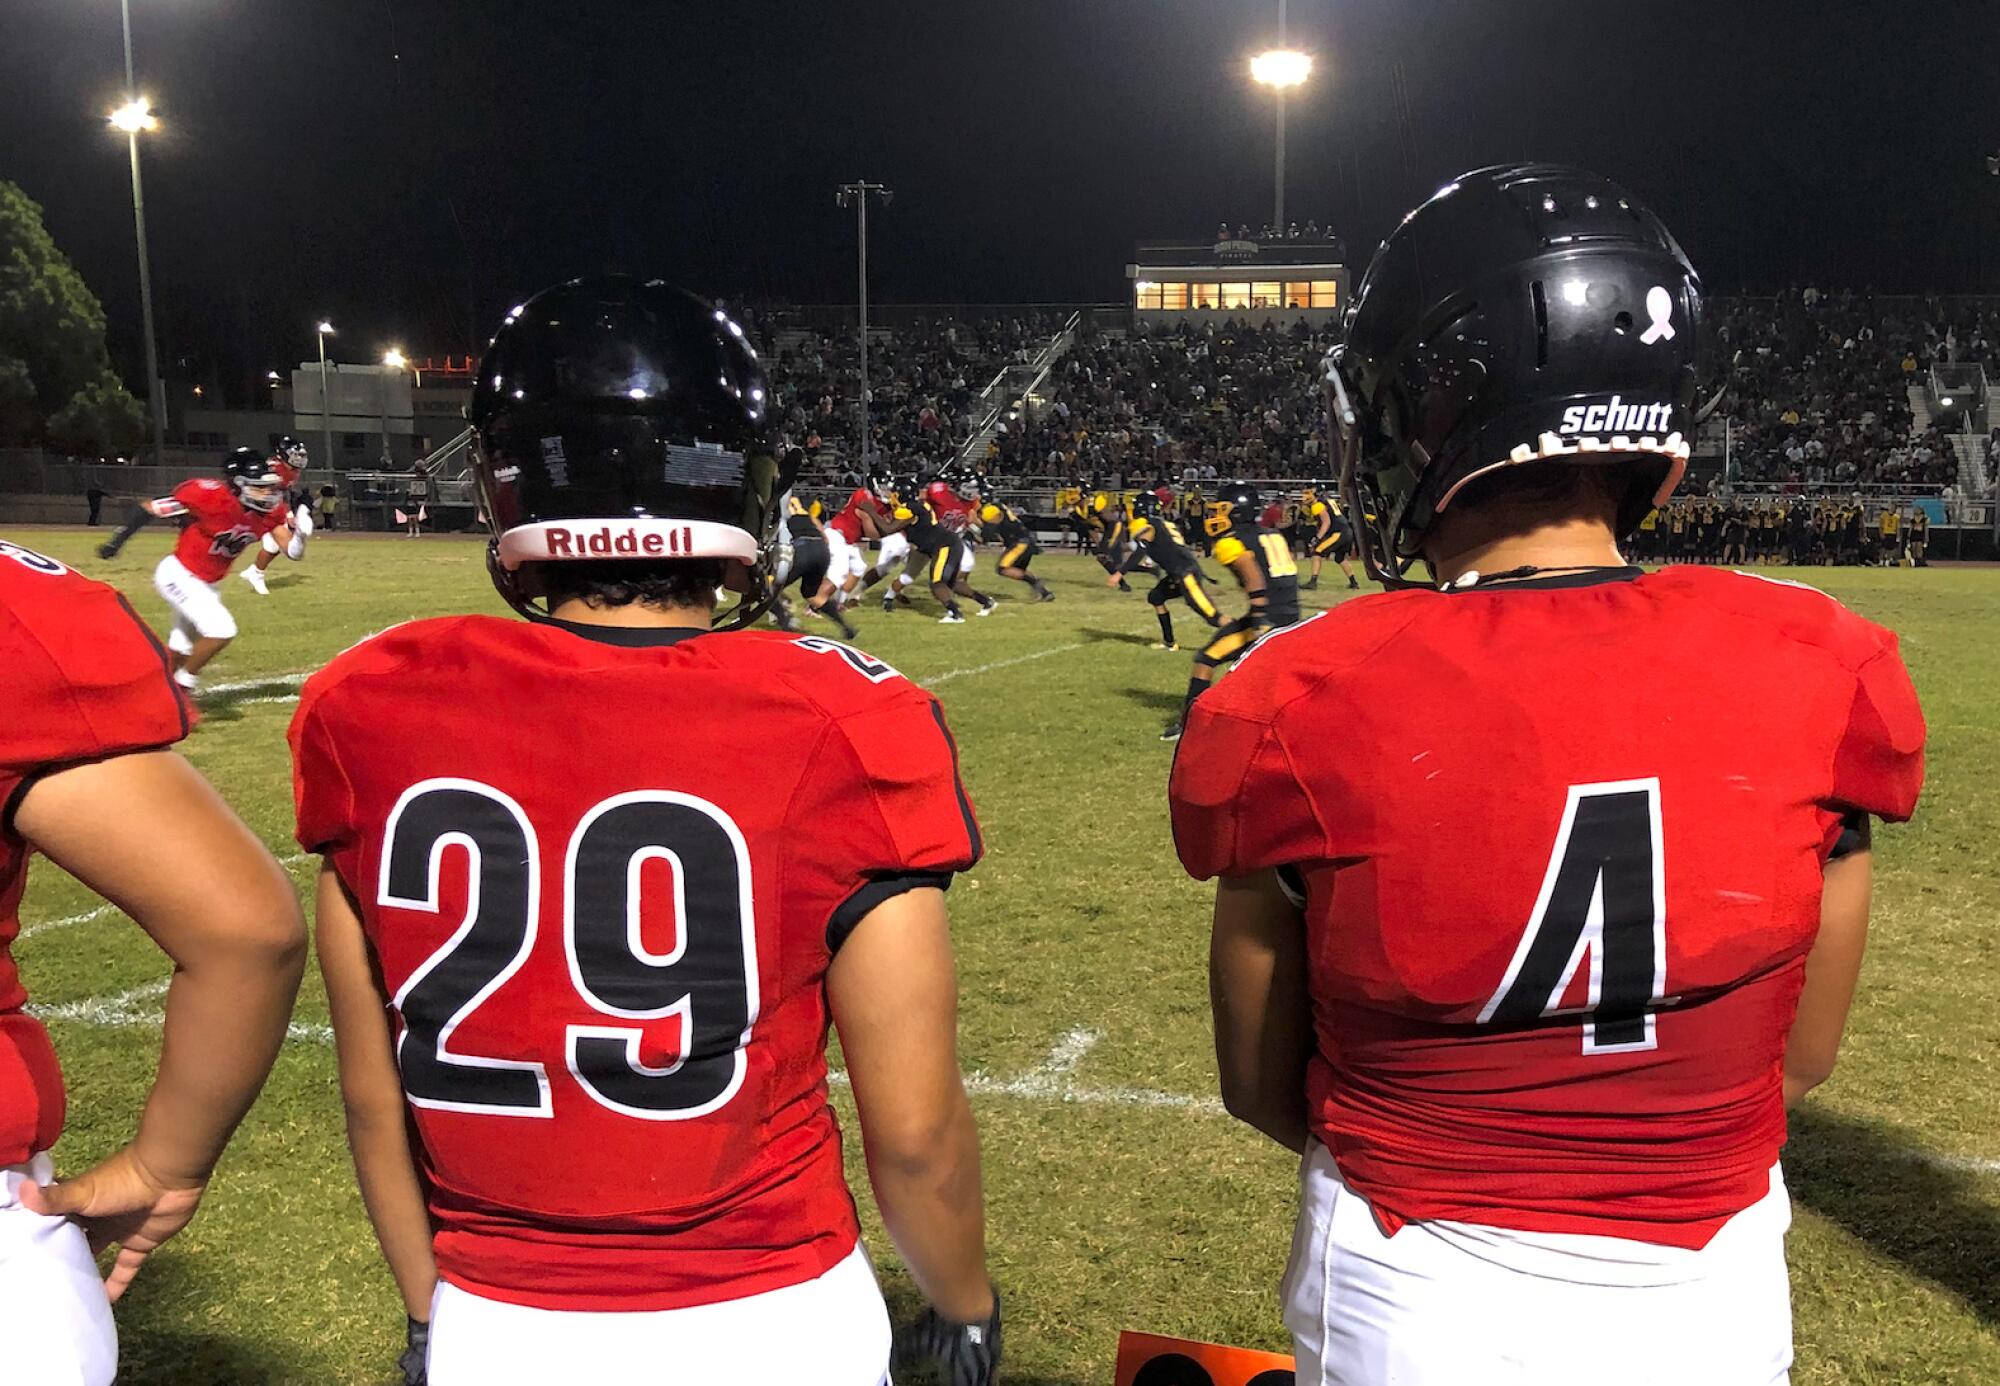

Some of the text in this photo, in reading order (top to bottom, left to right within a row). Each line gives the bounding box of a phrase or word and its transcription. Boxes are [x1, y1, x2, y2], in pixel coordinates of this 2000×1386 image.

[1560, 395, 1673, 433] schutt
[545, 527, 693, 556] Riddell
[377, 777, 761, 1121] 29
[1475, 777, 1682, 1056] 4
